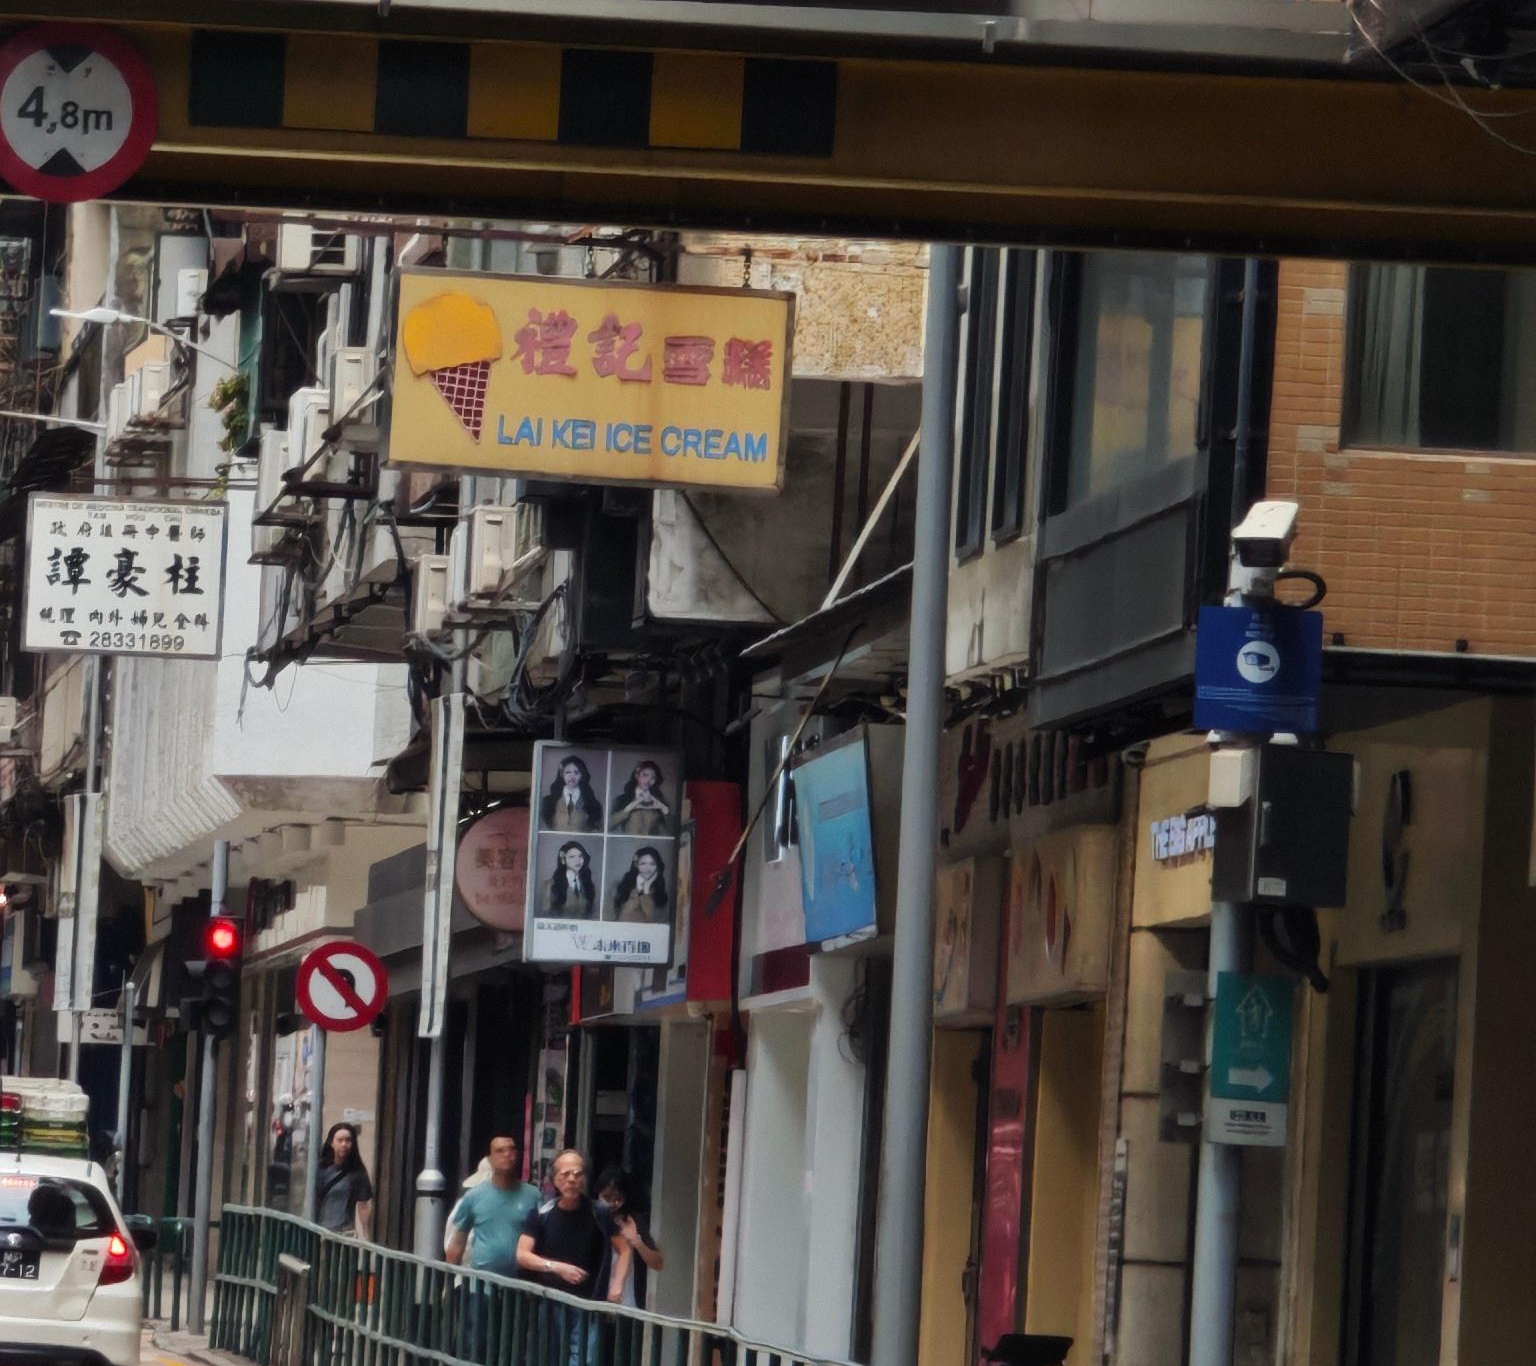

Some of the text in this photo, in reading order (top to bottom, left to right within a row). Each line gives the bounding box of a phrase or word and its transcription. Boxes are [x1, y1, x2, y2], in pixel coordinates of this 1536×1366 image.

[497, 414, 768, 463] LAI KEI ICE CREAM
[46, 547, 204, 598] 譚豪柱
